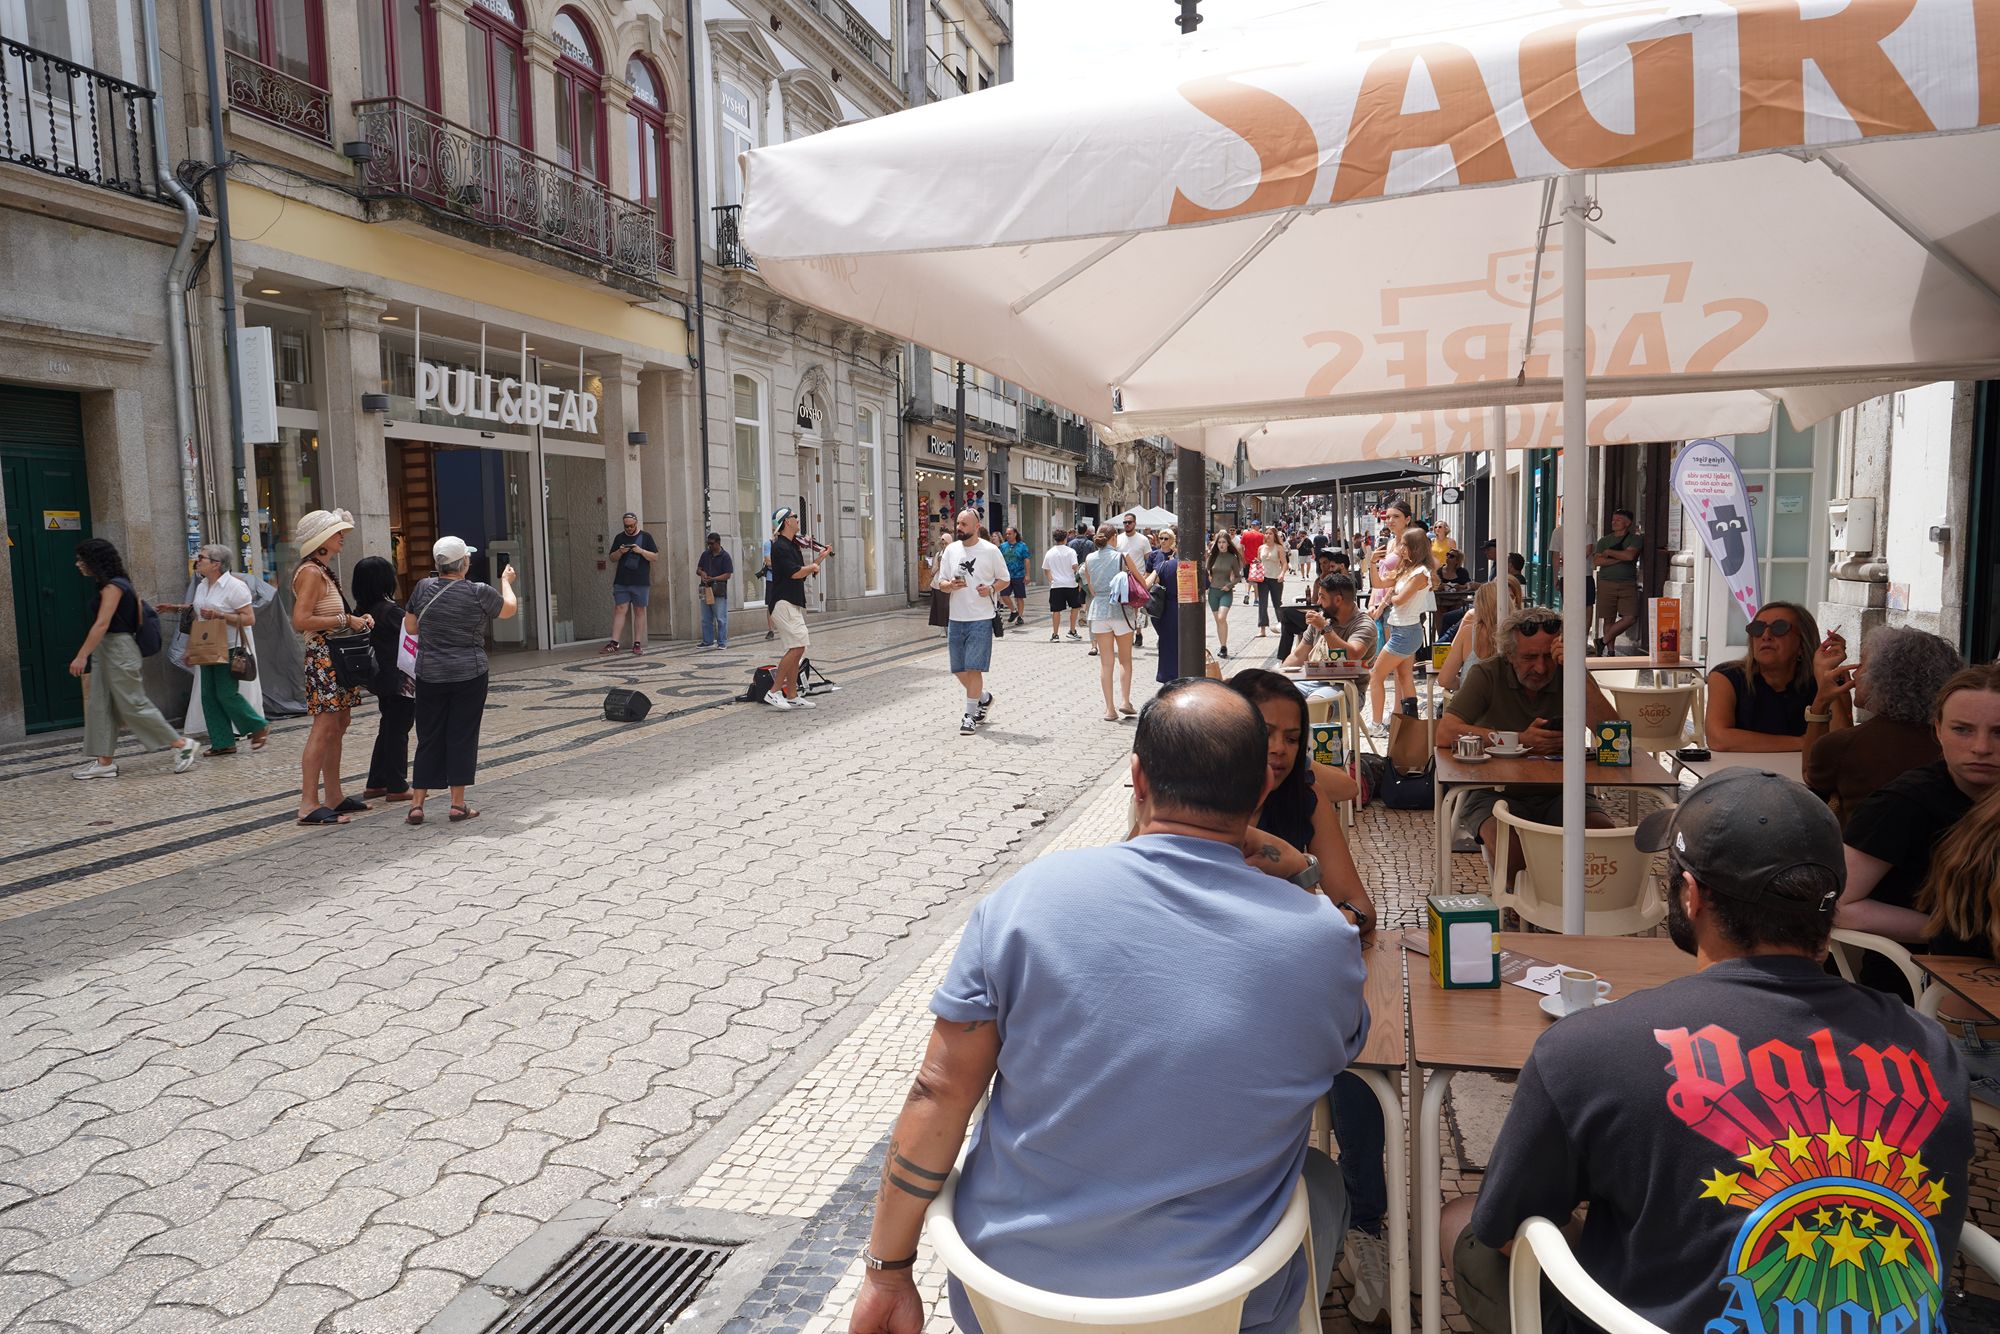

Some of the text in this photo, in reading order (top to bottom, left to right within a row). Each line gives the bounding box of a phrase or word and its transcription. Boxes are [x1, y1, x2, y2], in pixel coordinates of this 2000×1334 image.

[1168, 0, 2000, 224] SAGR
[414, 361, 598, 434] PULL&BEAR
[800, 405, 822, 421] OYSHO
[931, 435, 981, 462] Ricami onica
[1024, 456, 1069, 486] BRUXELAS
[1638, 706, 1672, 718] SAGRES
[1653, 1023, 1949, 1127] Palm
[1703, 1273, 1948, 1334] Angel
